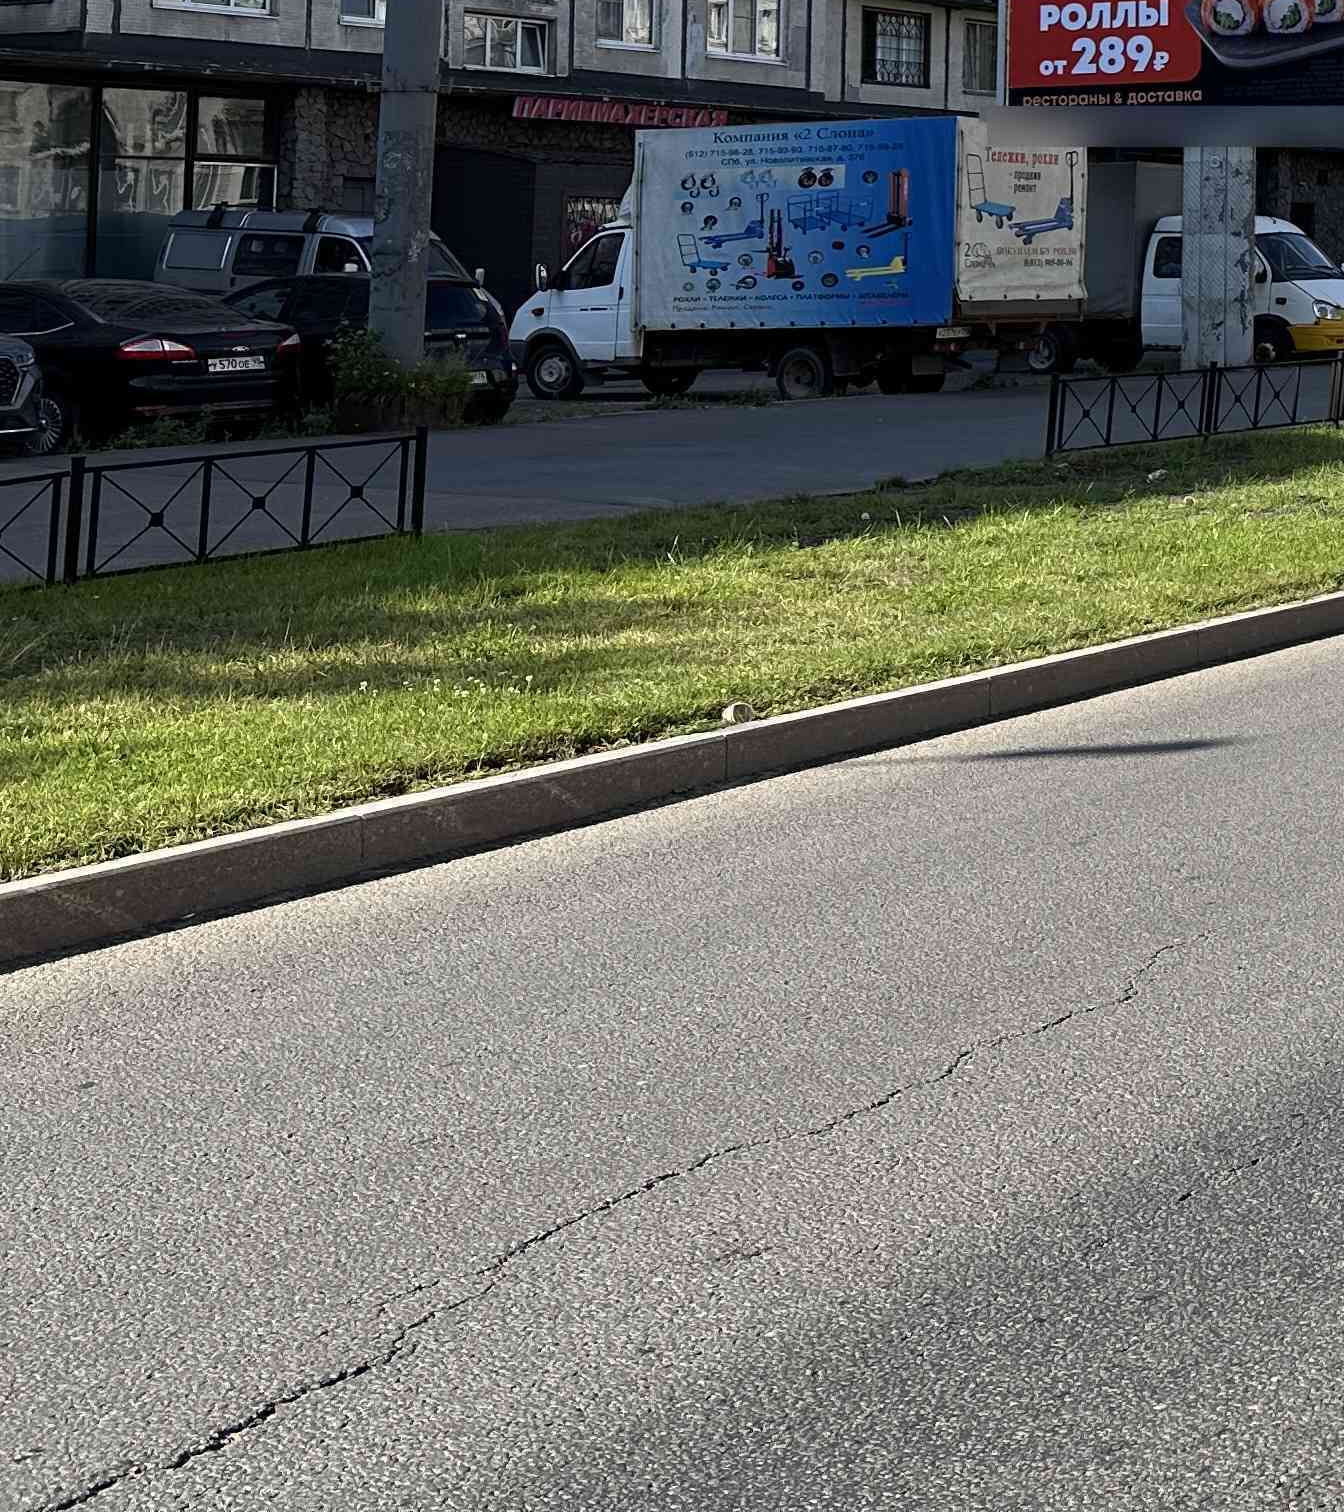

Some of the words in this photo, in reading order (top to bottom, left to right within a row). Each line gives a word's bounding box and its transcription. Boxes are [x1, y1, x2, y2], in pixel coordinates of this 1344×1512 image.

[1039, 0, 1169, 32] РОЛЛЫ
[1022, 91, 1111, 107] рестораны
[1113, 90, 1124, 104] &
[1126, 88, 1202, 105] доставка
[512, 95, 729, 127] ПАРИКМАХЕРСКАЯ
[713, 131, 790, 144] Компания
